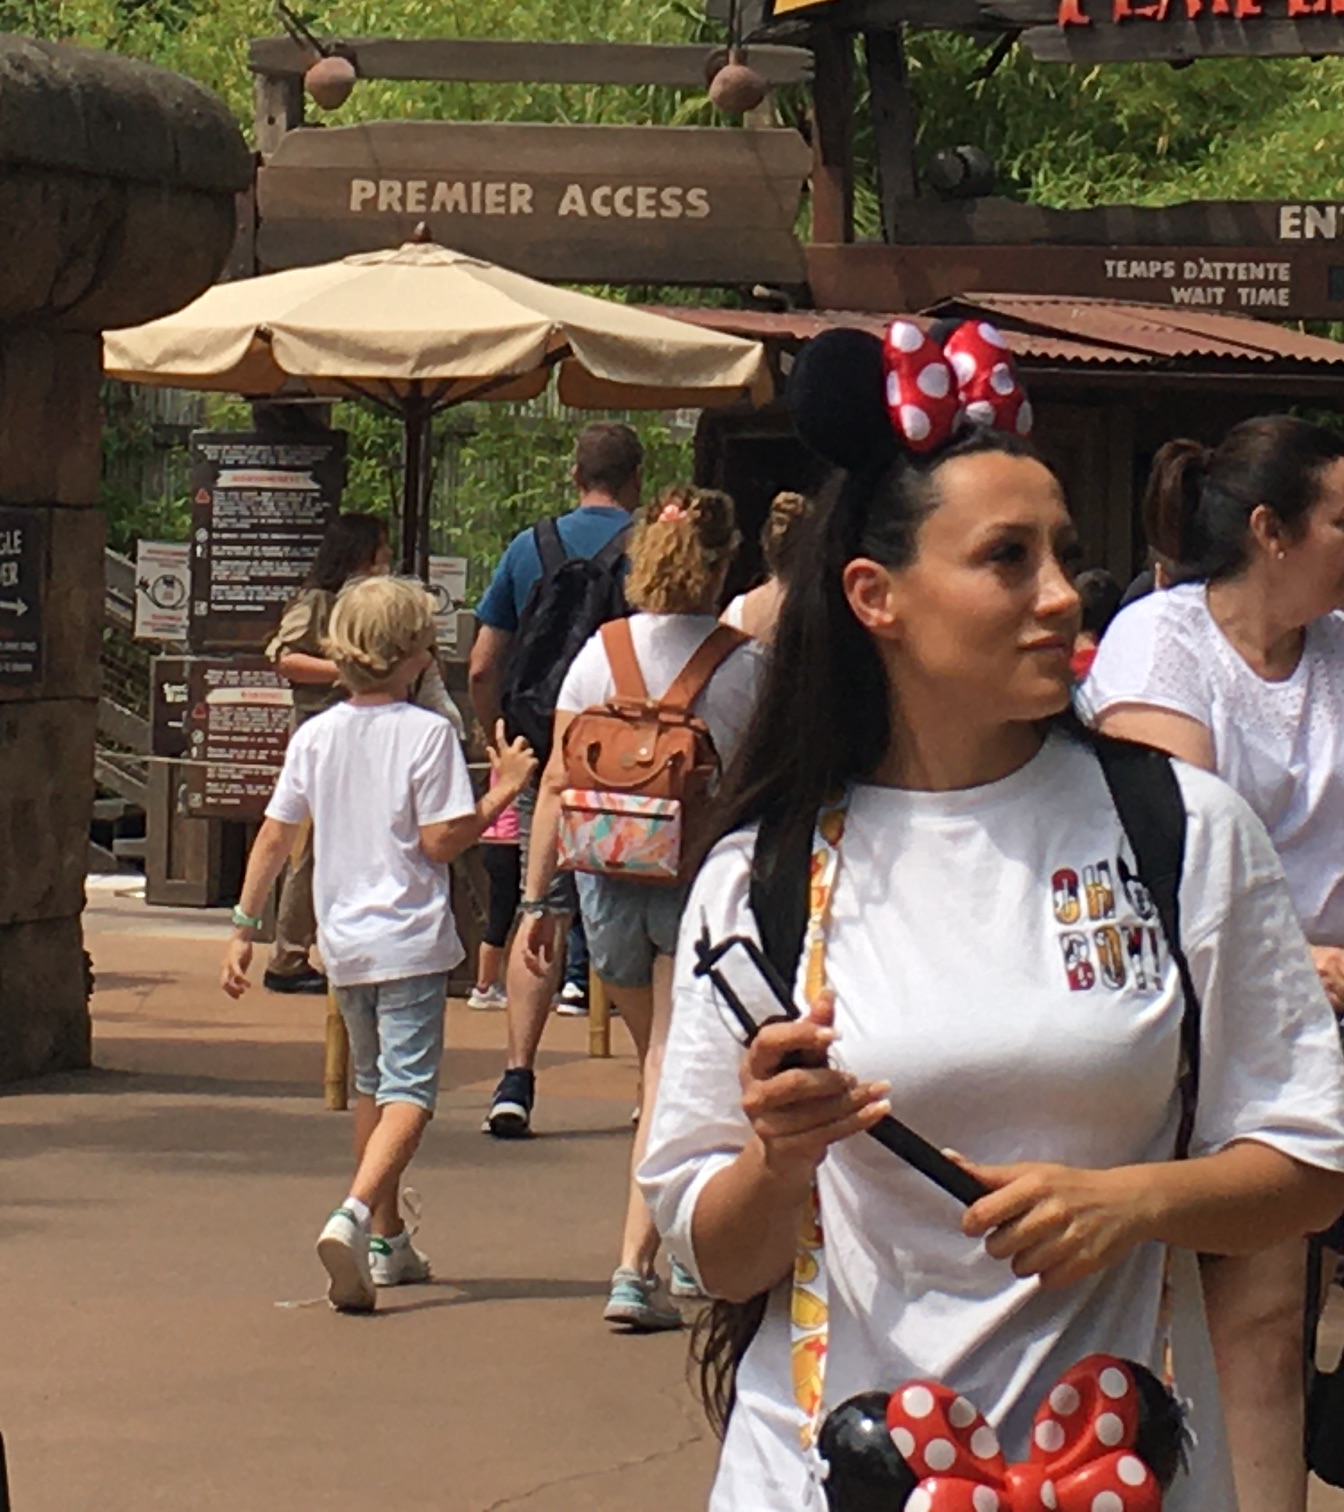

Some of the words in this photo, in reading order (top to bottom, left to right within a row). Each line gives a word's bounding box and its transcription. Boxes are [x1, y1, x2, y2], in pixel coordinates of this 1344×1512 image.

[349, 178, 534, 215] PREMIER
[558, 183, 711, 220] ACCESS
[1105, 259, 1175, 279] TEMPS
[1183, 257, 1291, 282] D'ATTENTE
[1171, 285, 1226, 306] WAIT
[1237, 286, 1290, 307] TIME
